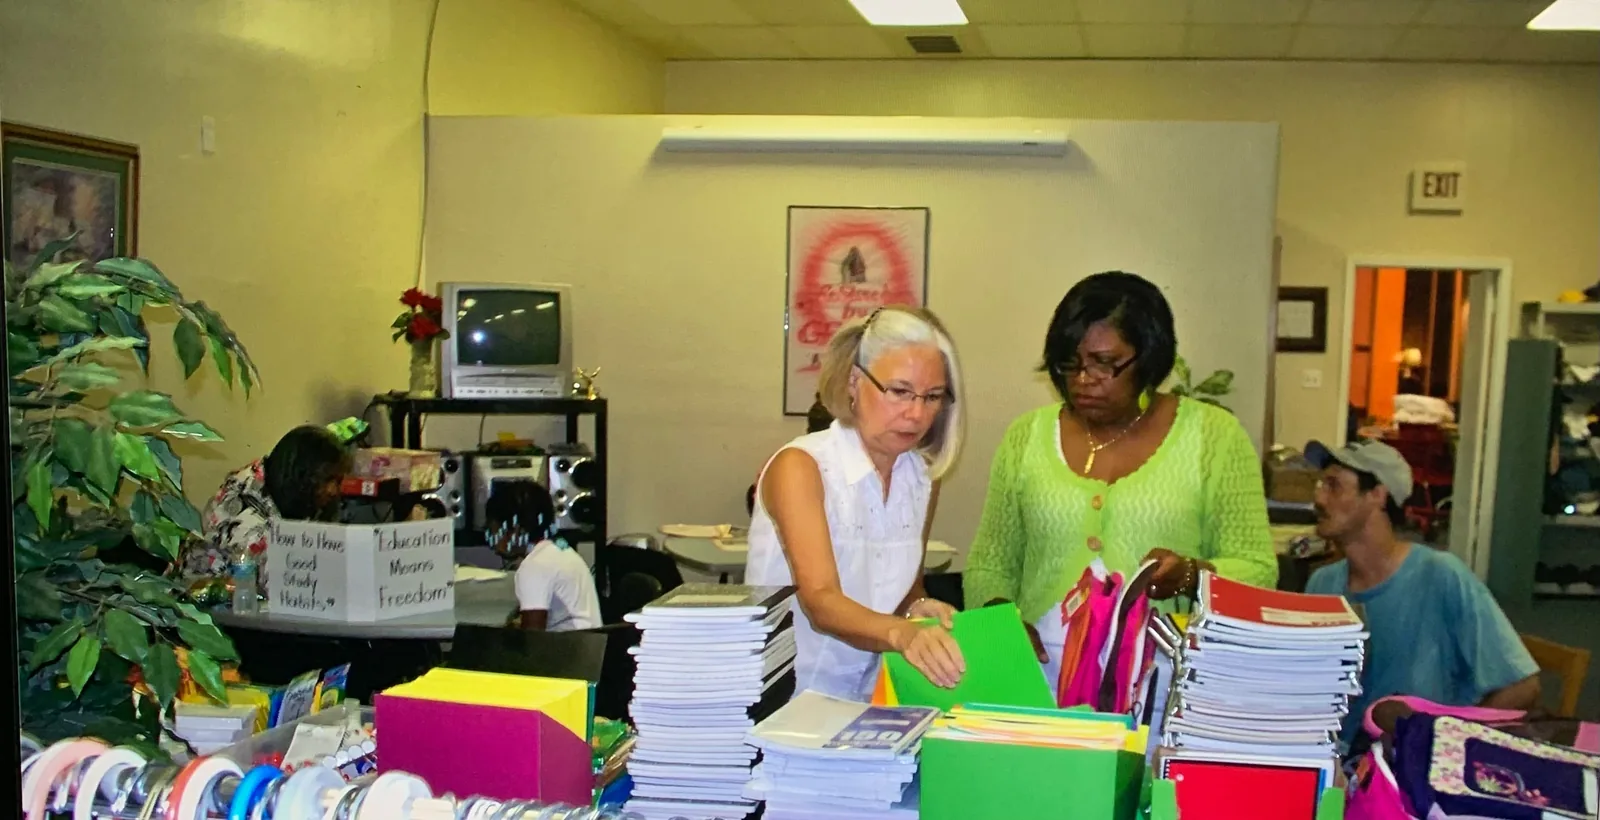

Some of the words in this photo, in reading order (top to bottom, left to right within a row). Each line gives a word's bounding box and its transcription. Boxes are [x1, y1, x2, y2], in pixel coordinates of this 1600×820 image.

[1423, 171, 1462, 198] EXIT
[301, 530, 314, 549] to
[316, 529, 345, 554] Have
[285, 551, 317, 572] Good
[389, 557, 435, 577] Means
[283, 571, 318, 597] Study
